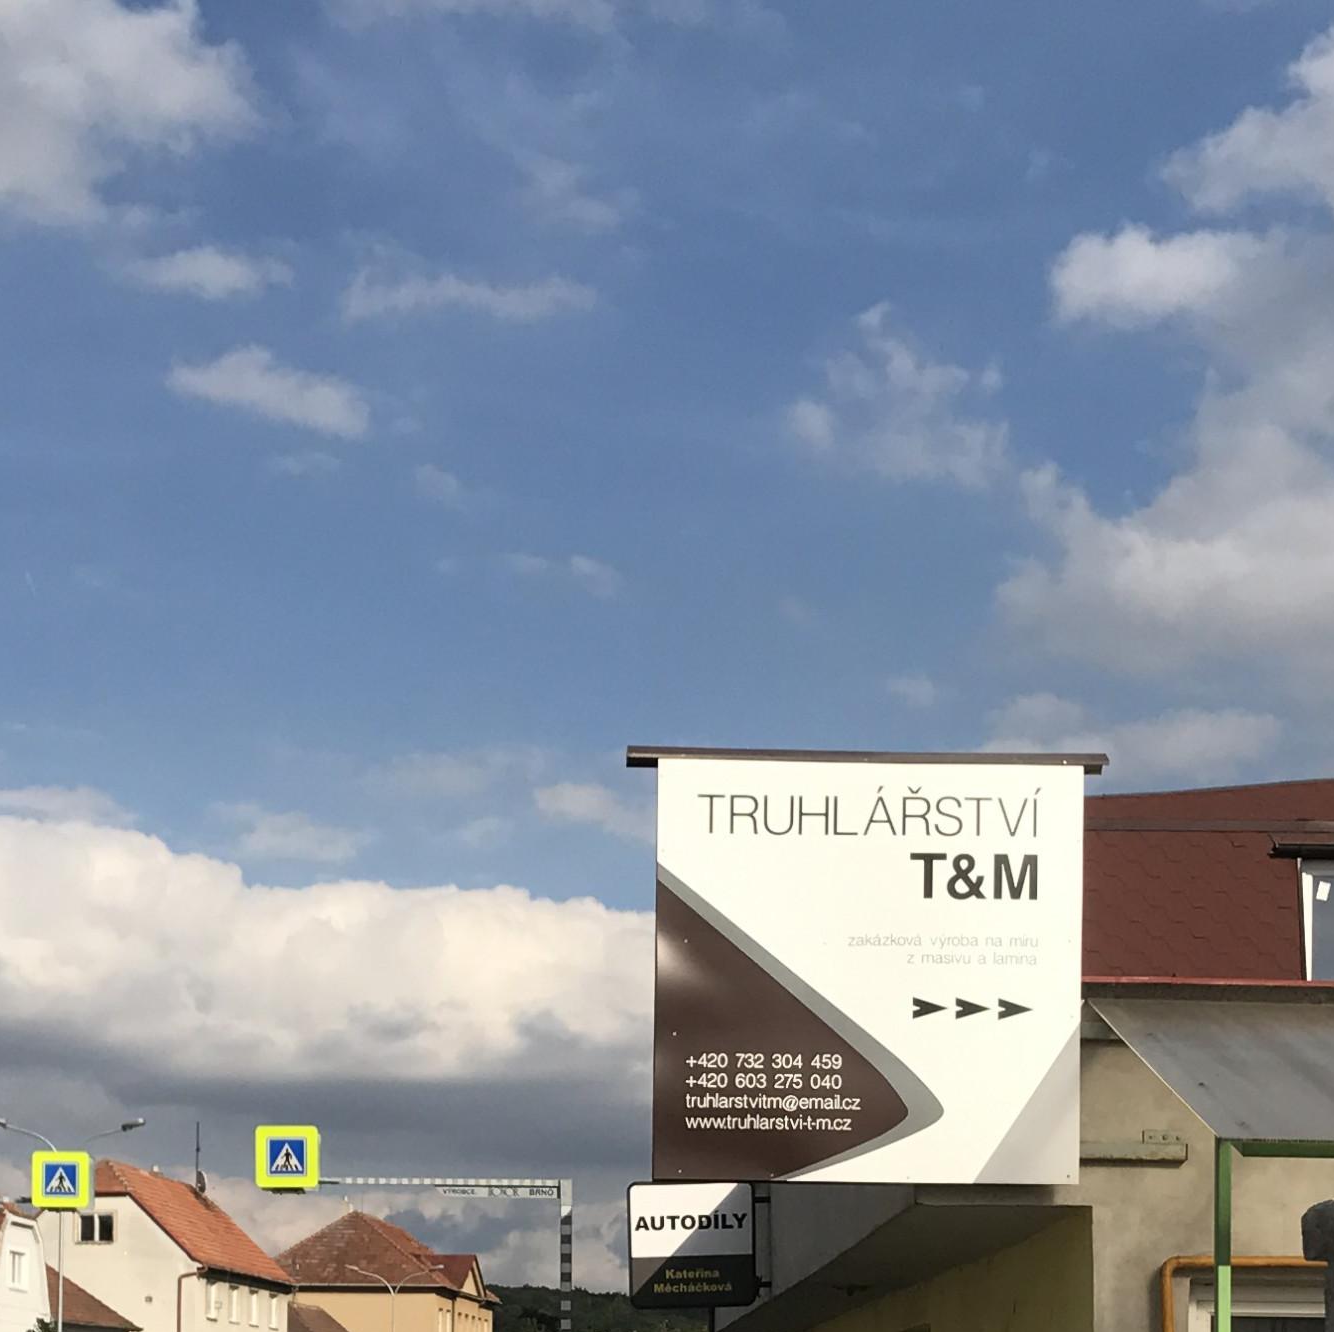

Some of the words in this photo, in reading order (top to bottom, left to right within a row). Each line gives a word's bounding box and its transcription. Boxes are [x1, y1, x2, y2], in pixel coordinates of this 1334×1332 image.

[697, 786, 1042, 838] TRUHLÁŘSTVÍ
[910, 852, 1038, 900] T&M
[847, 933, 922, 947] zakázková
[930, 934, 979, 949] výroba
[985, 936, 1003, 947] na
[907, 953, 915, 964] z
[921, 952, 971, 965] masivu
[977, 954, 987, 965] a
[993, 952, 1038, 966] lamina
[685, 1053, 728, 1068] +420
[735, 1053, 764, 1068] 732
[771, 1054, 803, 1069] 304
[810, 1054, 843, 1069] 459
[685, 1073, 728, 1088] +420
[735, 1073, 767, 1088] 603
[773, 1074, 803, 1089] 275
[810, 1074, 842, 1090] 040
[685, 1093, 861, 1111] truhlarstvitm@email.cz
[685, 1114, 852, 1131] www.truhlarstvi-t-m.cz
[635, 1211, 748, 1231] AUTODÍLY
